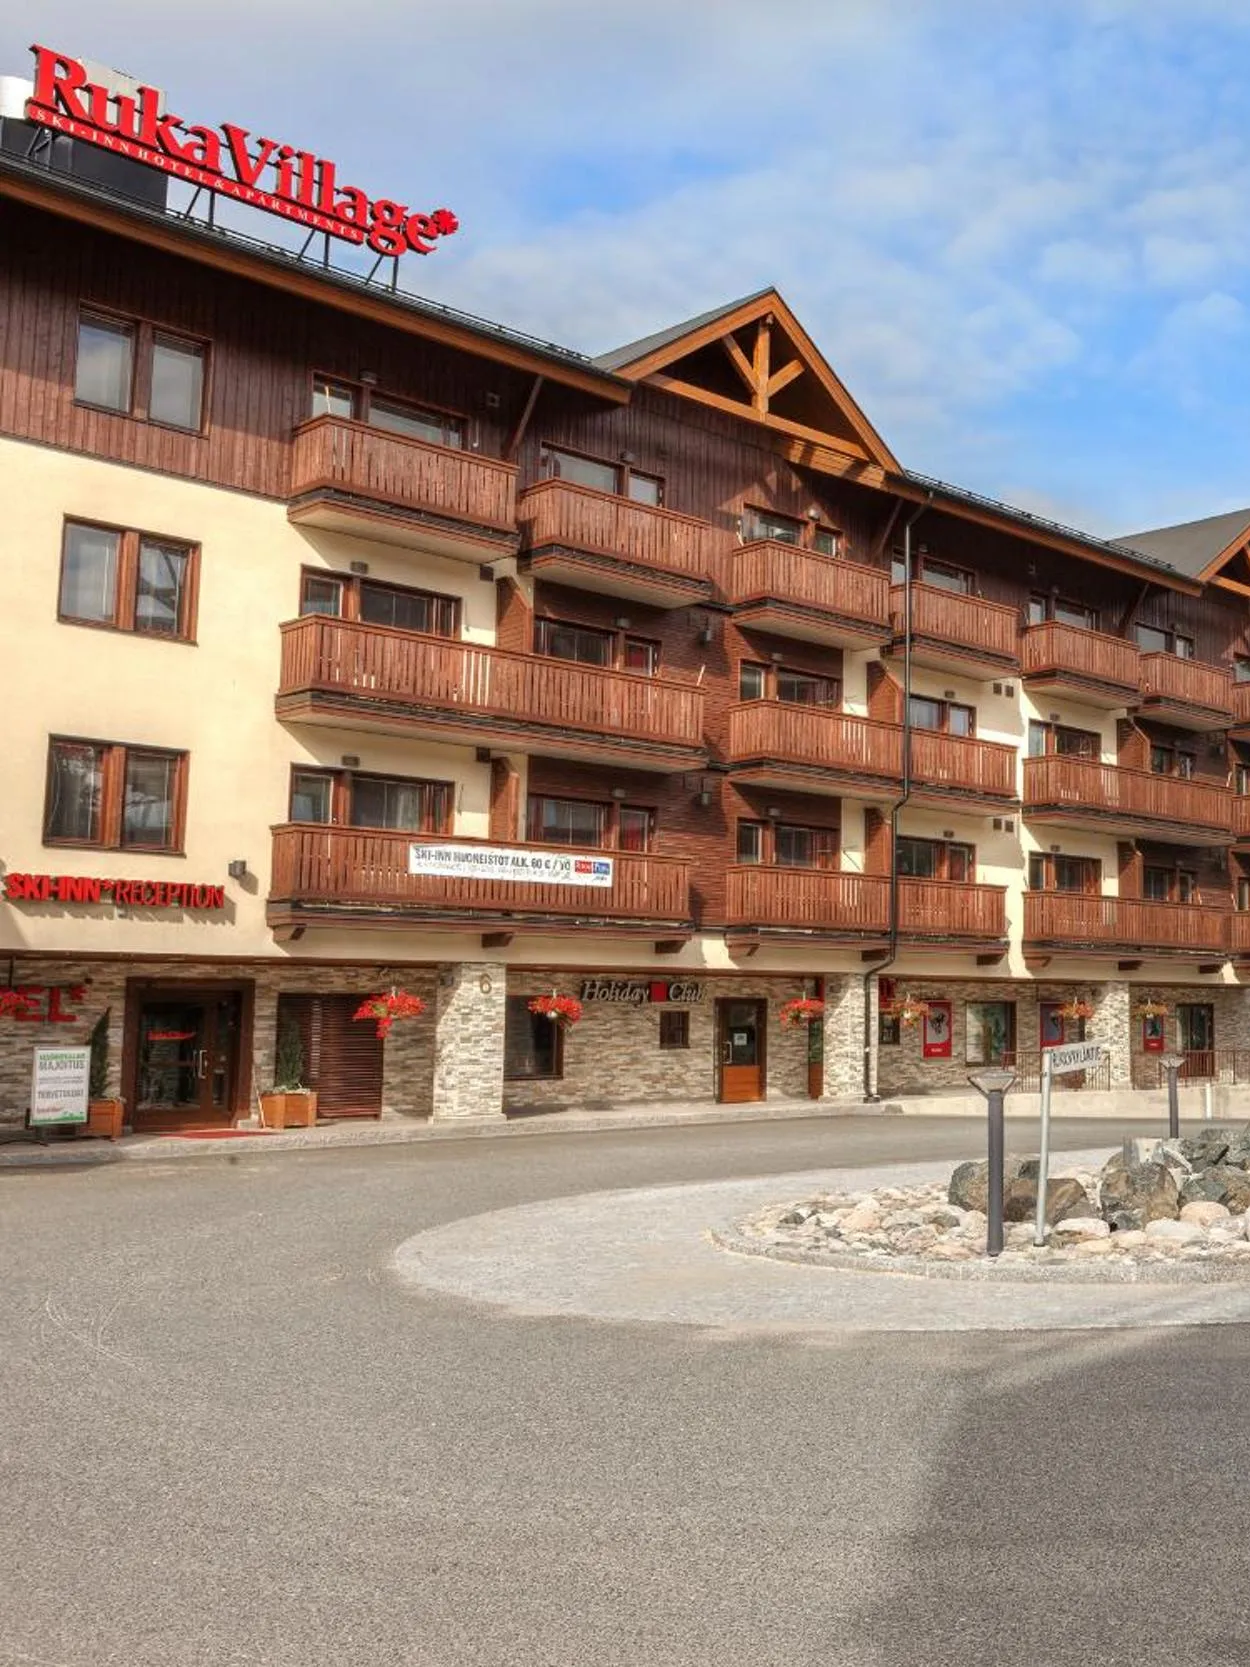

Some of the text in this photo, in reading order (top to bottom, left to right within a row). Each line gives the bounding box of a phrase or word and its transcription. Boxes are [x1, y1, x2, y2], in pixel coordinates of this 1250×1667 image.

[29, 44, 438, 256] RukaVillage
[36, 108, 358, 240] SKI-INN HOTEL & APARTMENTS
[414, 847, 452, 862] SKI-INN
[5, 872, 225, 909] SKI-INN RECEPTION
[480, 972, 493, 995] 6
[582, 980, 704, 1006] Holiday Club
